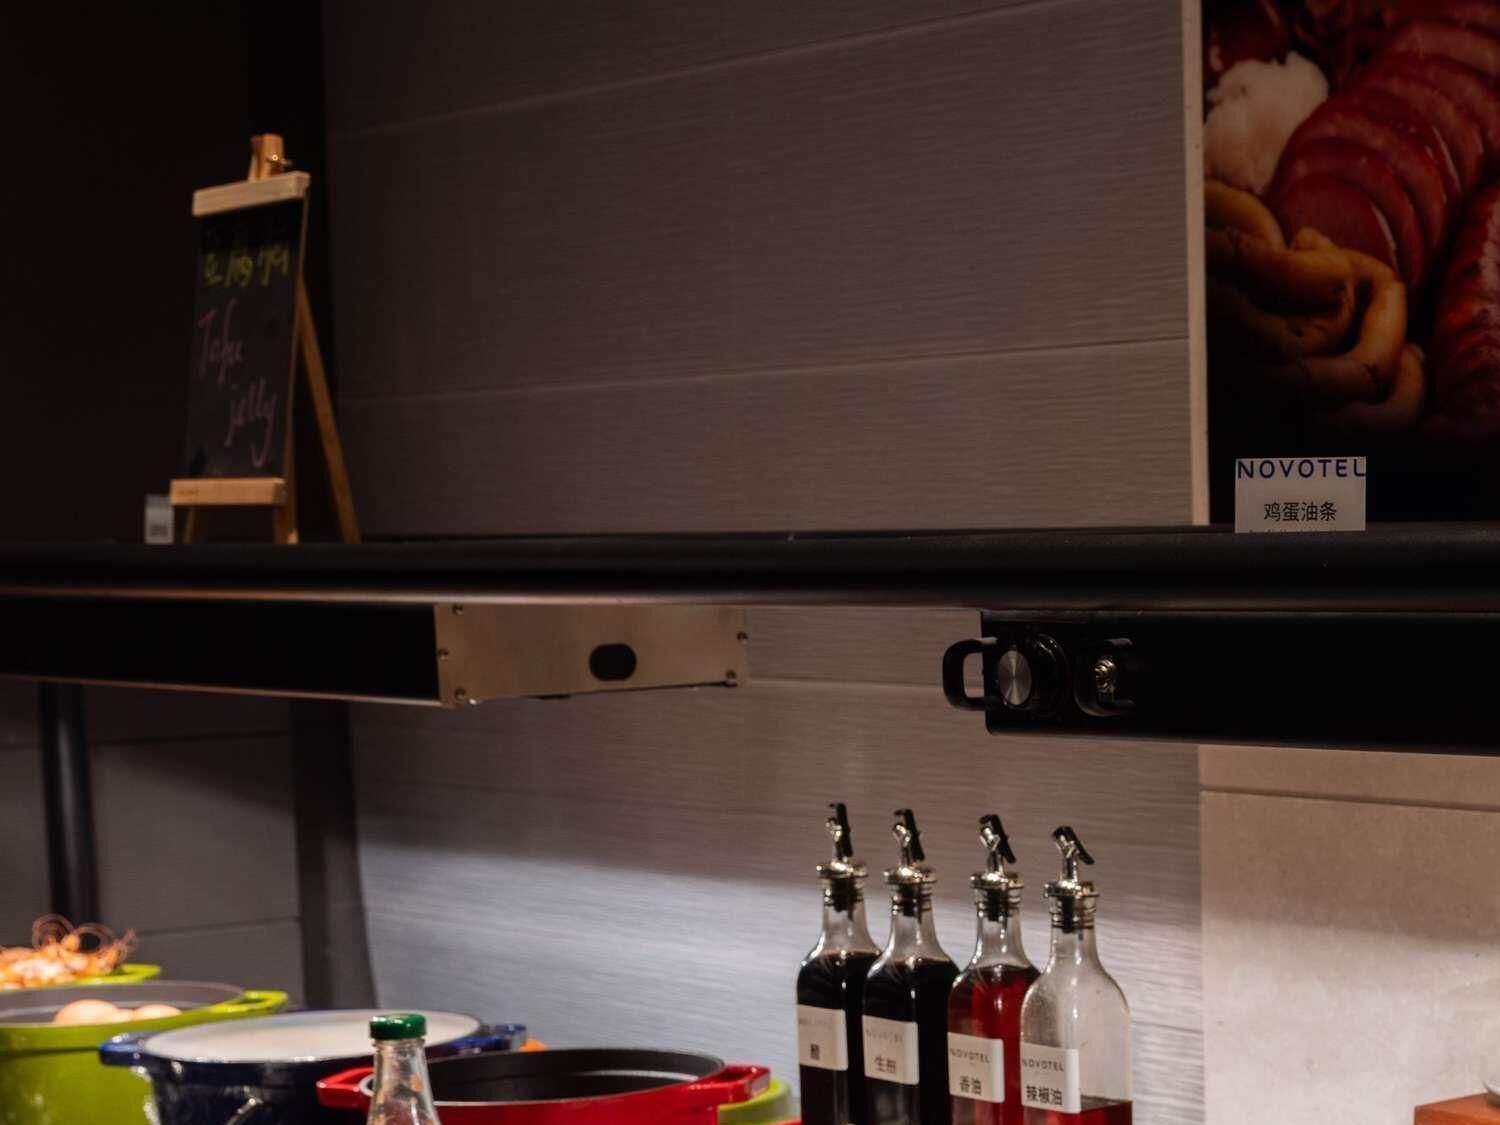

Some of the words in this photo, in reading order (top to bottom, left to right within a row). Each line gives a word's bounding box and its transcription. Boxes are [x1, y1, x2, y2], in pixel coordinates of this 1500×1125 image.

[1237, 459, 1366, 479] NOVOTEL
[1264, 501, 1337, 522] 鸡蛋油条
[950, 1047, 991, 1064] NOVOTEL
[1021, 1058, 1065, 1072] NOVOTEL
